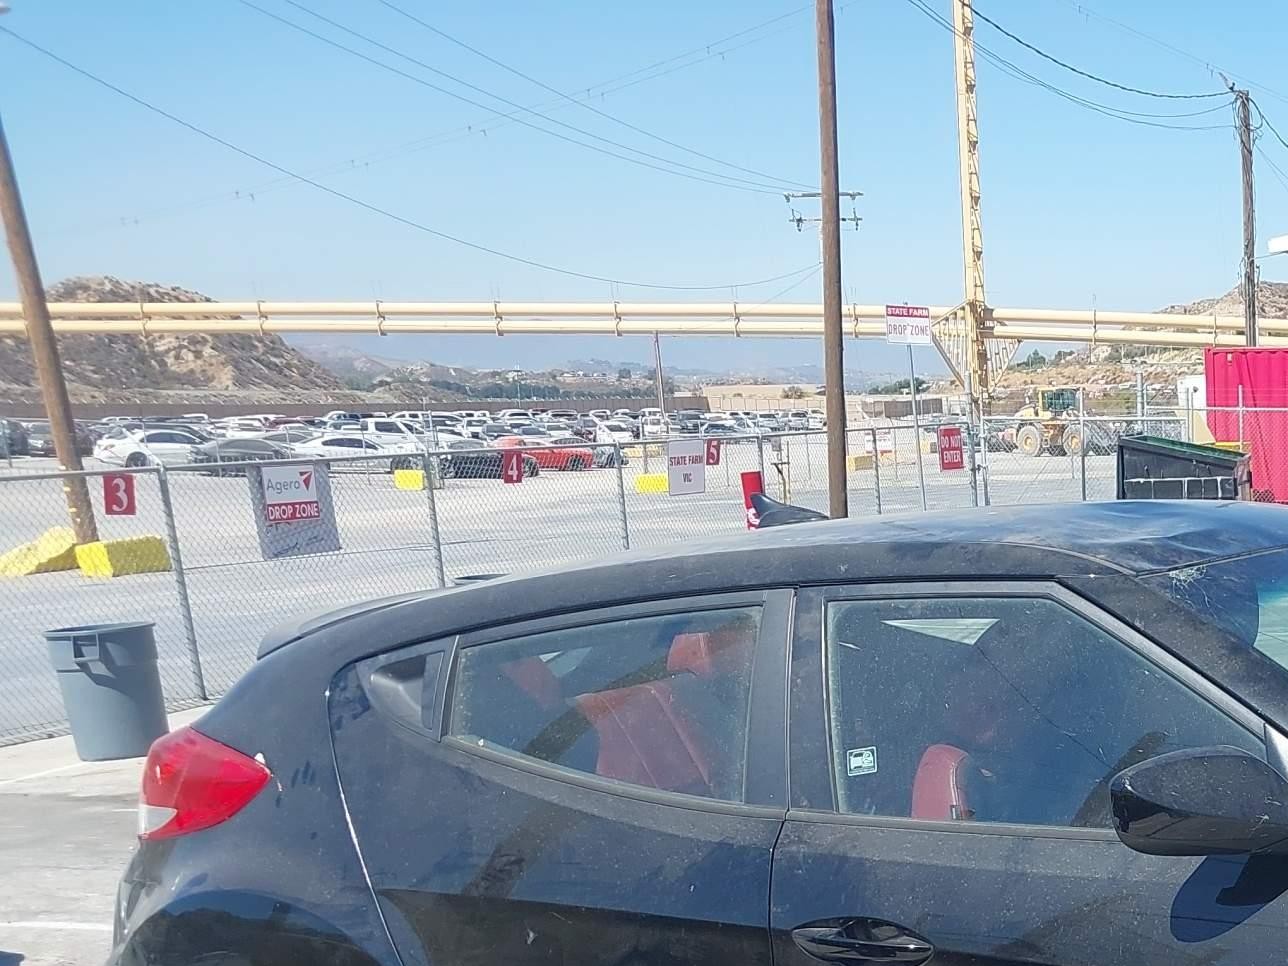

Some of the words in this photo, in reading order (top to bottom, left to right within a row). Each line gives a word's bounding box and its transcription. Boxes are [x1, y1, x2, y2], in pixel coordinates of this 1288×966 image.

[887, 307, 908, 316] STATE
[909, 308, 929, 317] FARM
[889, 324, 907, 335] DROP
[910, 325, 930, 337] ZONE
[941, 435, 950, 449] DO
[950, 435, 961, 448] NOT
[708, 440, 718, 464] 5
[943, 450, 962, 463] ENTER
[669, 455, 688, 466] STATE
[688, 454, 704, 465] FARM
[507, 454, 519, 481] 4
[682, 472, 692, 483] VIC
[266, 478, 301, 495] Agero
[111, 477, 129, 512] 3
[268, 504, 294, 520] DROP
[295, 502, 320, 518] ZONE
